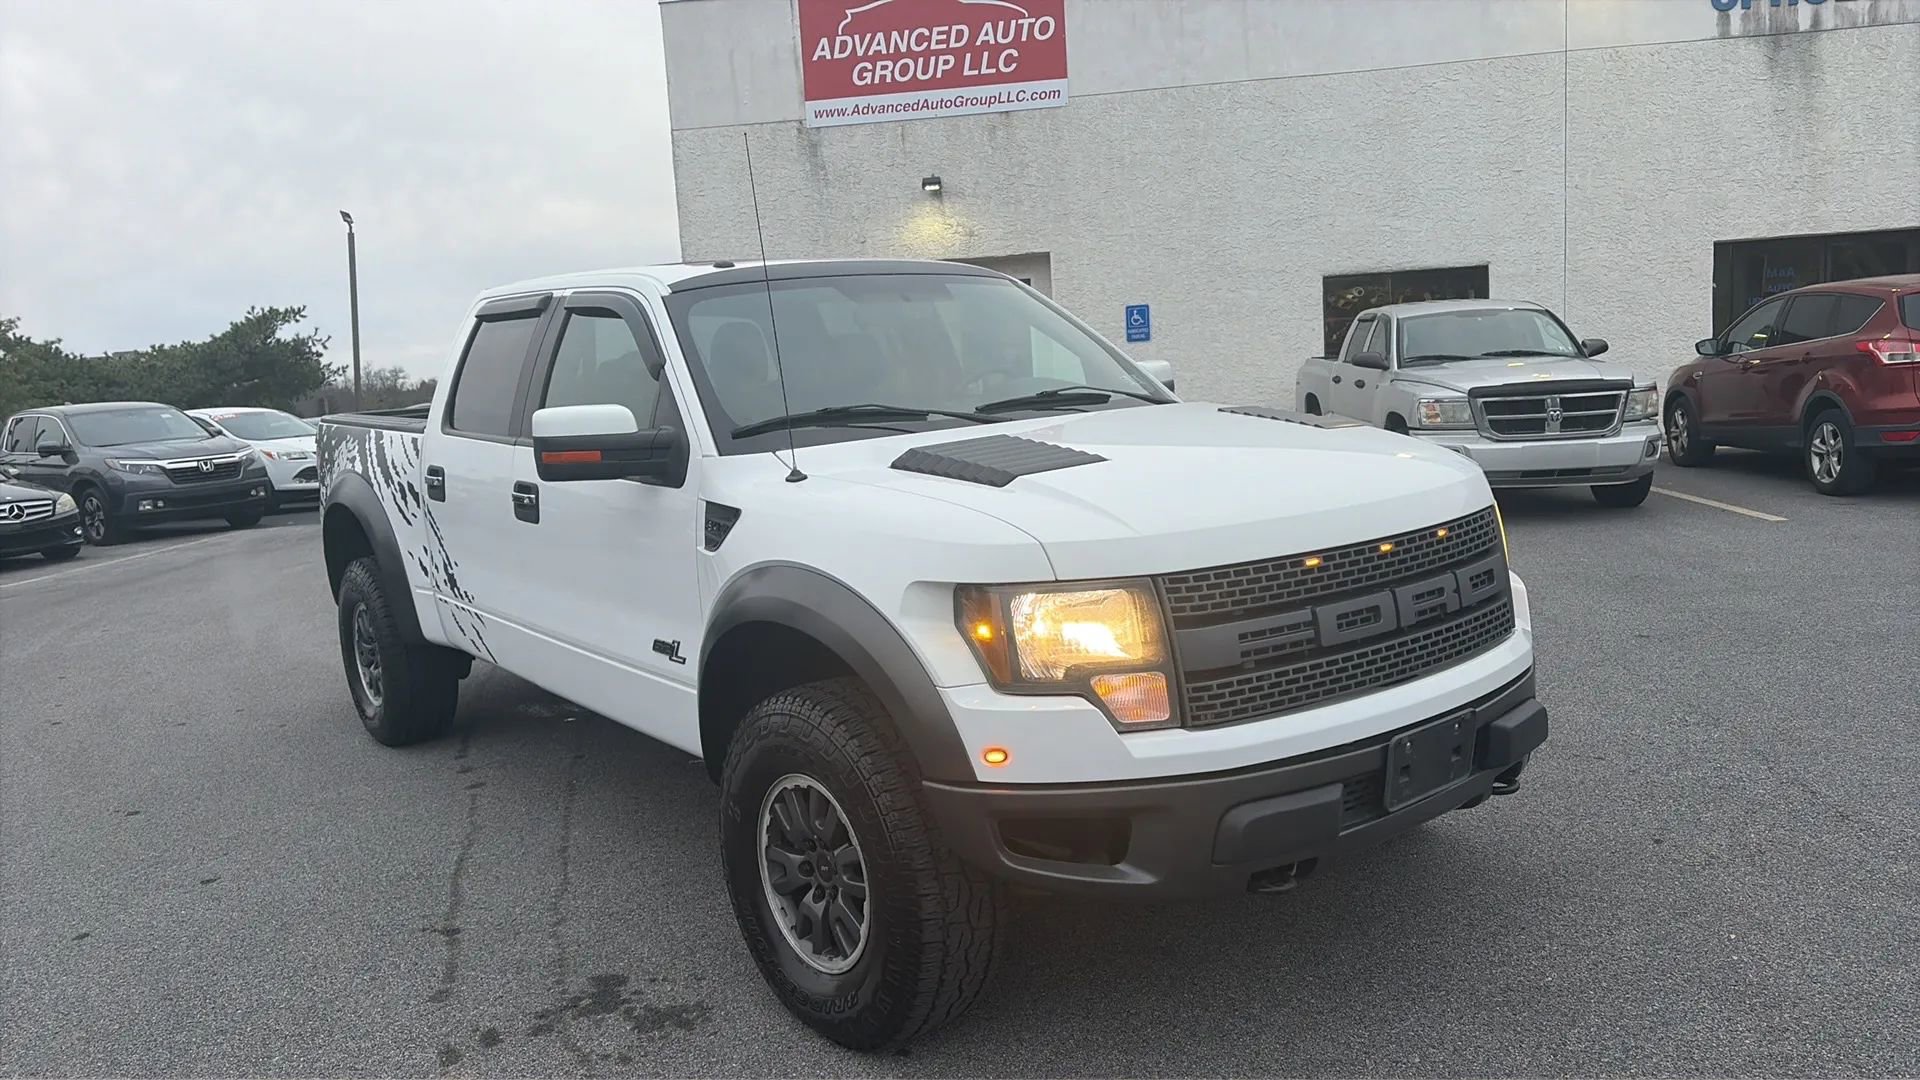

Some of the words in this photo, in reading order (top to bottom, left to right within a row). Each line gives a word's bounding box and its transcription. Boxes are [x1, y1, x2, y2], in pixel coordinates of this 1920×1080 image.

[812, 24, 969, 61] ADVANCED
[975, 16, 1056, 46] AUTO
[851, 54, 955, 86] GROUP
[963, 49, 1019, 76] LLC
[813, 87, 1062, 120] www.AdvancedAutoGroupLLC.com
[1182, 553, 1505, 669] FORD
